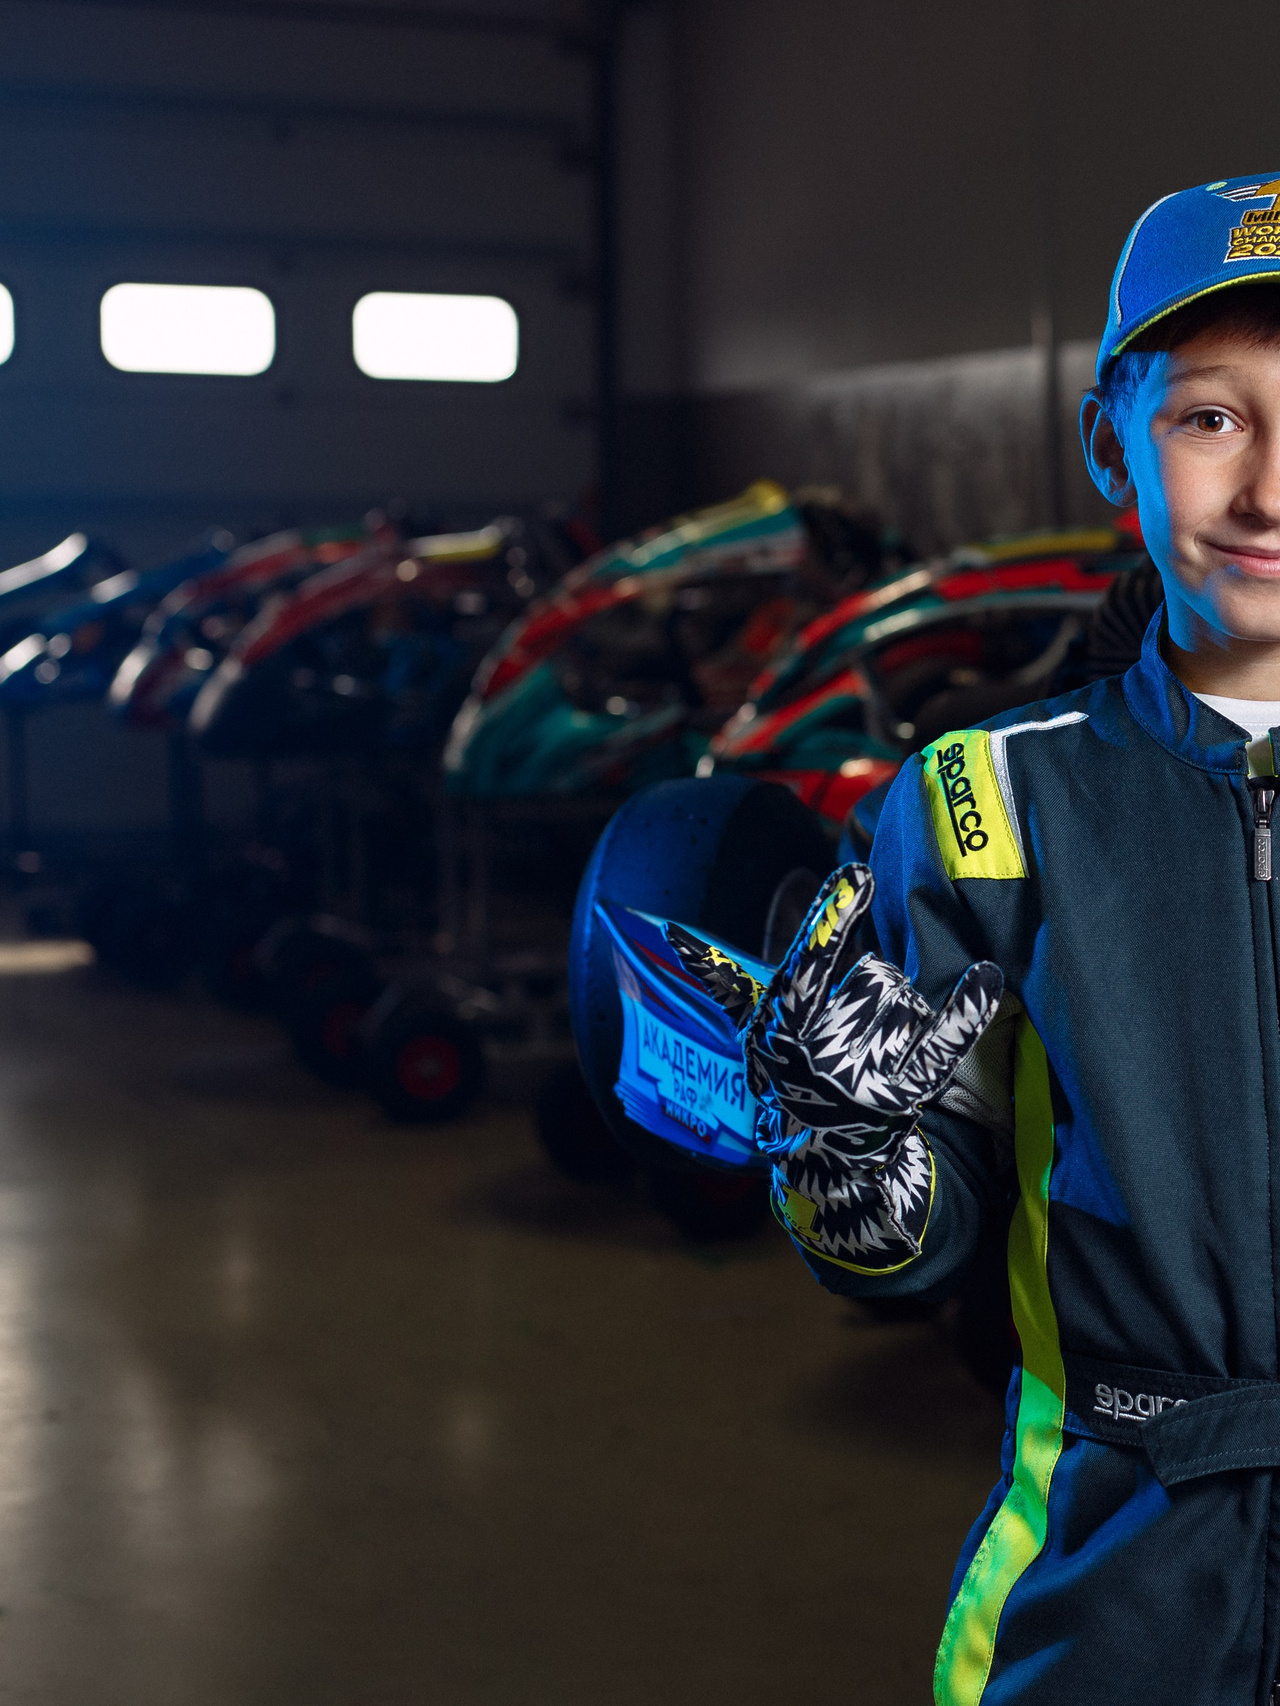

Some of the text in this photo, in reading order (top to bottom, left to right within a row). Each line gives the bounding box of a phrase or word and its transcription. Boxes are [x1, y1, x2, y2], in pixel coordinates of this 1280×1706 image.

[936, 742, 990, 857] sparco
[643, 1022, 746, 1112] АКАДЕМИЯ
[674, 1078, 698, 1108] РАФ
[665, 1099, 708, 1137] МИКРО
